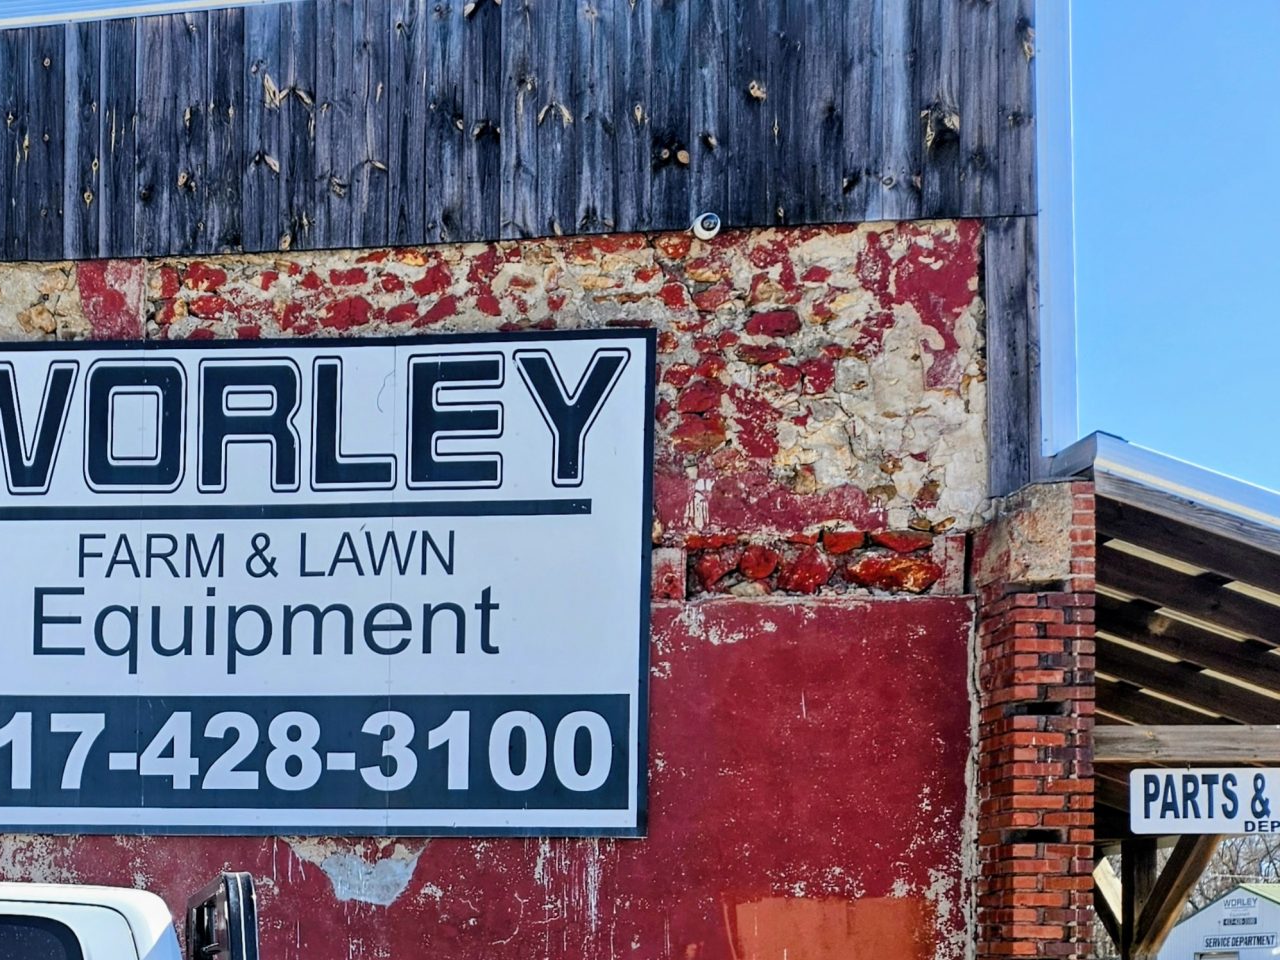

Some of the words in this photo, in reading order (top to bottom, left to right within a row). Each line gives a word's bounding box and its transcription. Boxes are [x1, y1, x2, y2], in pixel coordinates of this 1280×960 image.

[77, 532, 224, 578] FARM
[245, 532, 279, 578] &
[300, 530, 455, 577] LAWN
[32, 585, 500, 675] Equipment
[1144, 773, 1239, 819] PARTS
[1250, 773, 1271, 819] &
[1224, 898, 1258, 907] WORLEY
[1205, 937, 1231, 948] SERVICE
[1231, 935, 1275, 947] DEPARTMENT
